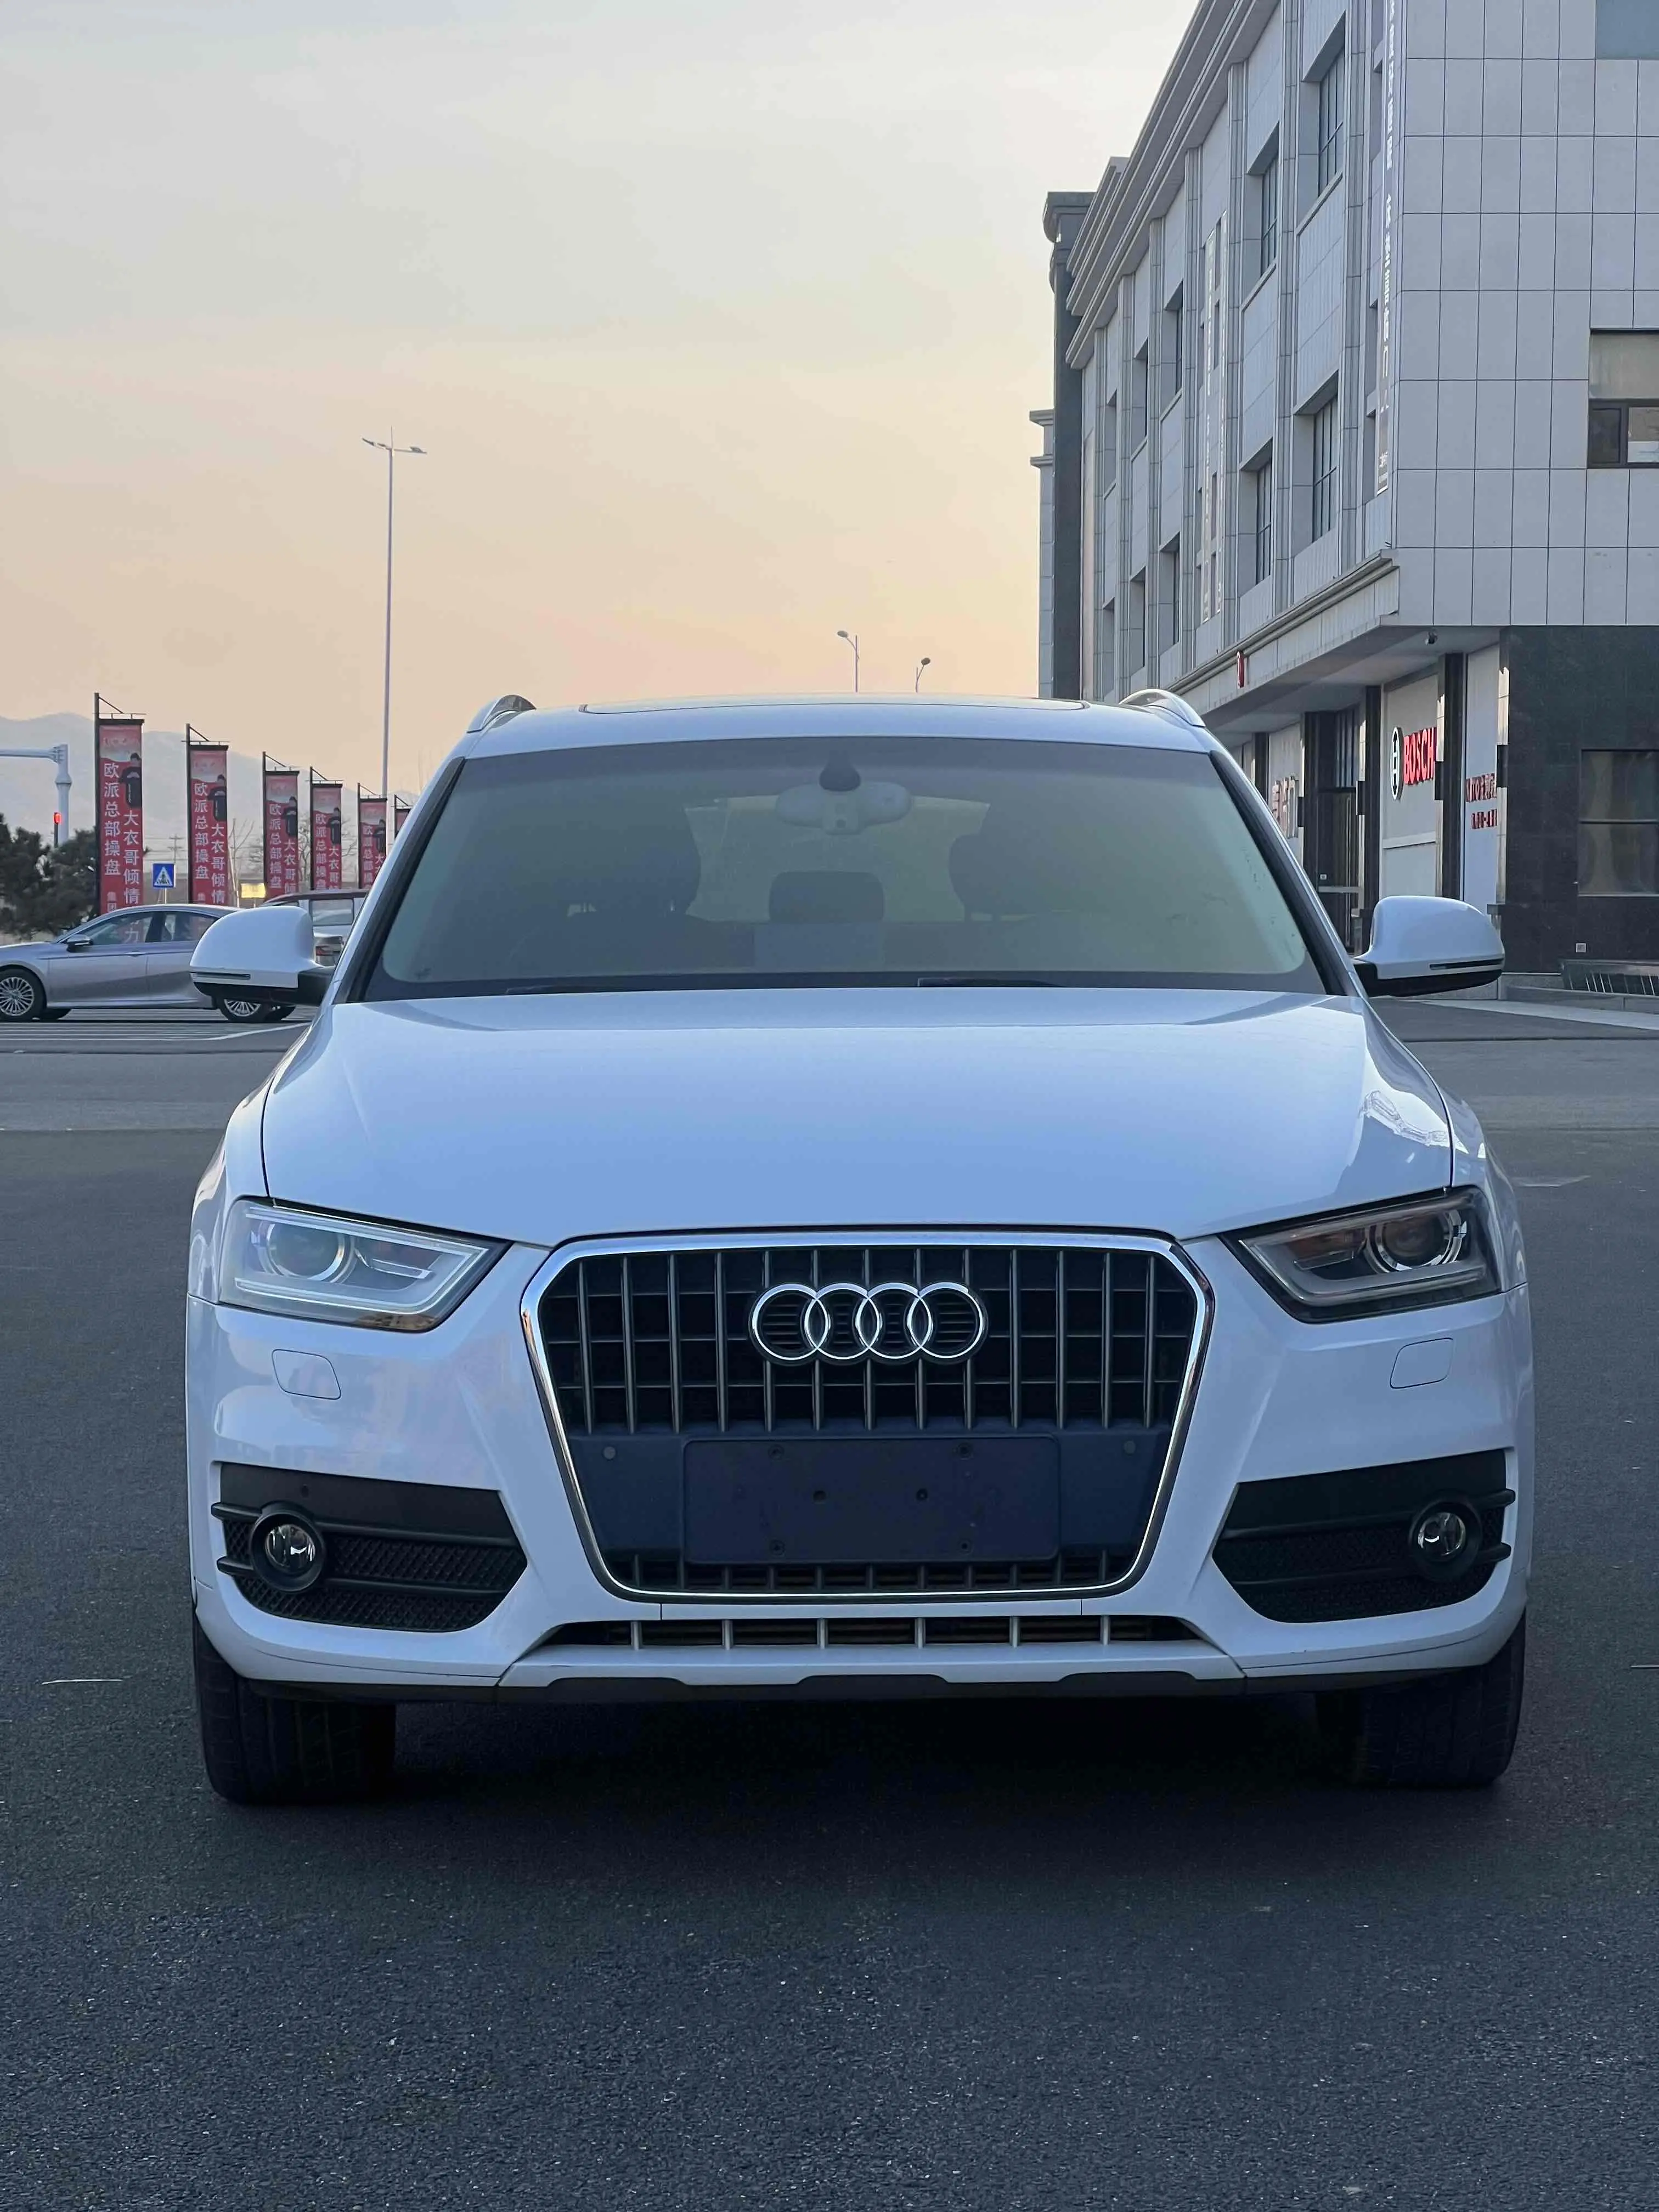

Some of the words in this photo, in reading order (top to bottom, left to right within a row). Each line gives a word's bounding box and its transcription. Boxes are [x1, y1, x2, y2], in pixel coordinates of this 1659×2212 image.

[1403, 727, 1435, 785] BOSCH
[104, 763, 120, 876] 欧派总部操盘
[194, 783, 209, 879] 欧派总部操盘
[269, 803, 282, 889] 欧派总部操盘
[211, 823, 225, 904] 大衣哥倾情
